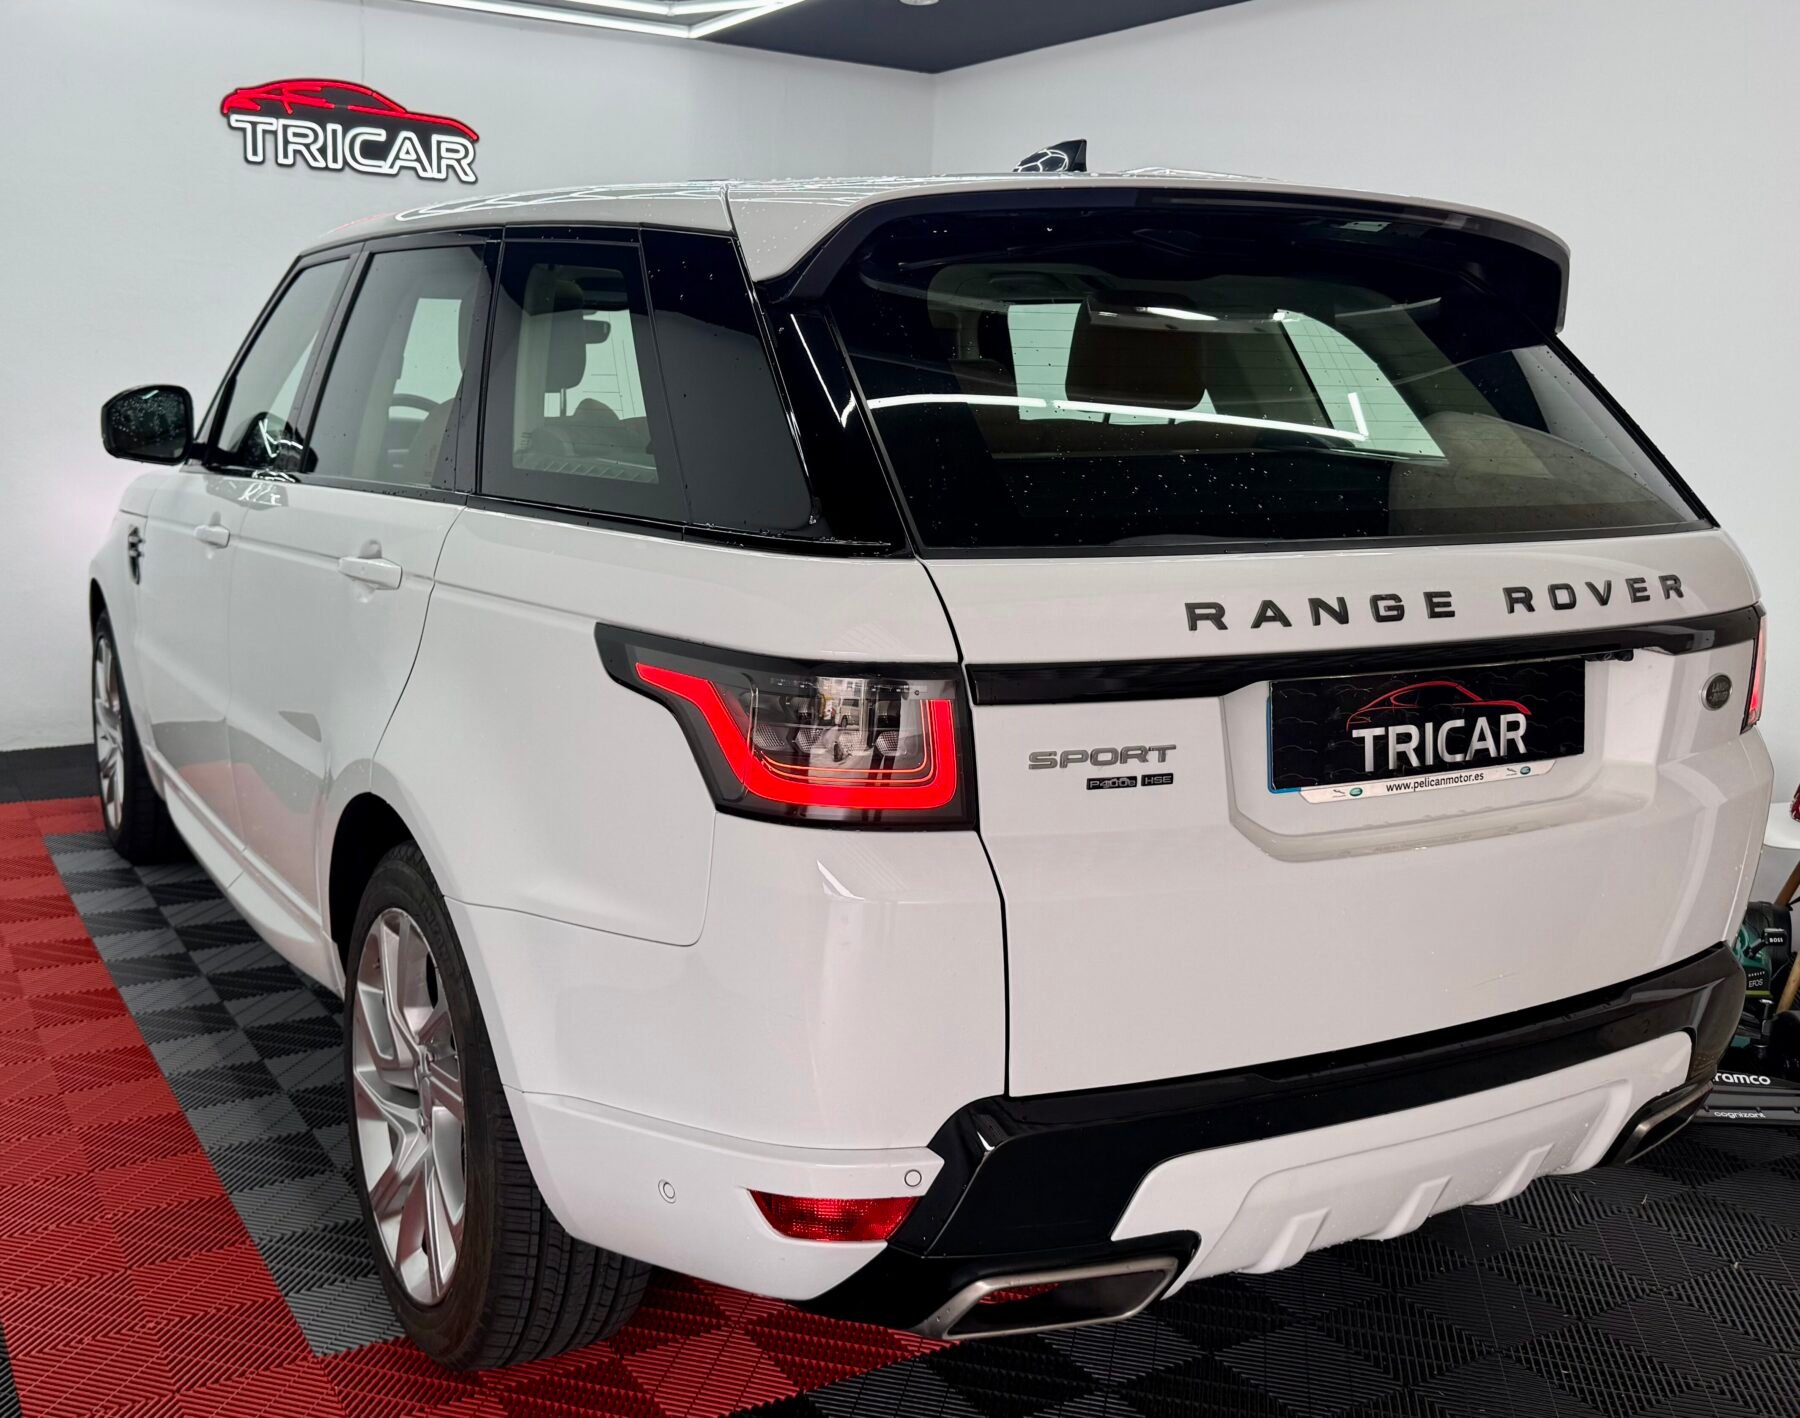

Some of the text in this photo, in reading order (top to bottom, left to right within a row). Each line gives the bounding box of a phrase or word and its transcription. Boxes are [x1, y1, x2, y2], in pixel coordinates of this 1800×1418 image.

[229, 114, 477, 182] TRICAR
[1185, 574, 1686, 631] RANGE ROVER
[1352, 713, 1527, 772] TRICAR
[1028, 744, 1177, 770] SPORT
[1144, 775, 1173, 785] HSE
[1386, 771, 1484, 793] www.pelicanmotor.es
[1712, 1072, 1771, 1085] ramco
[1714, 1111, 1766, 1119] cognizant
